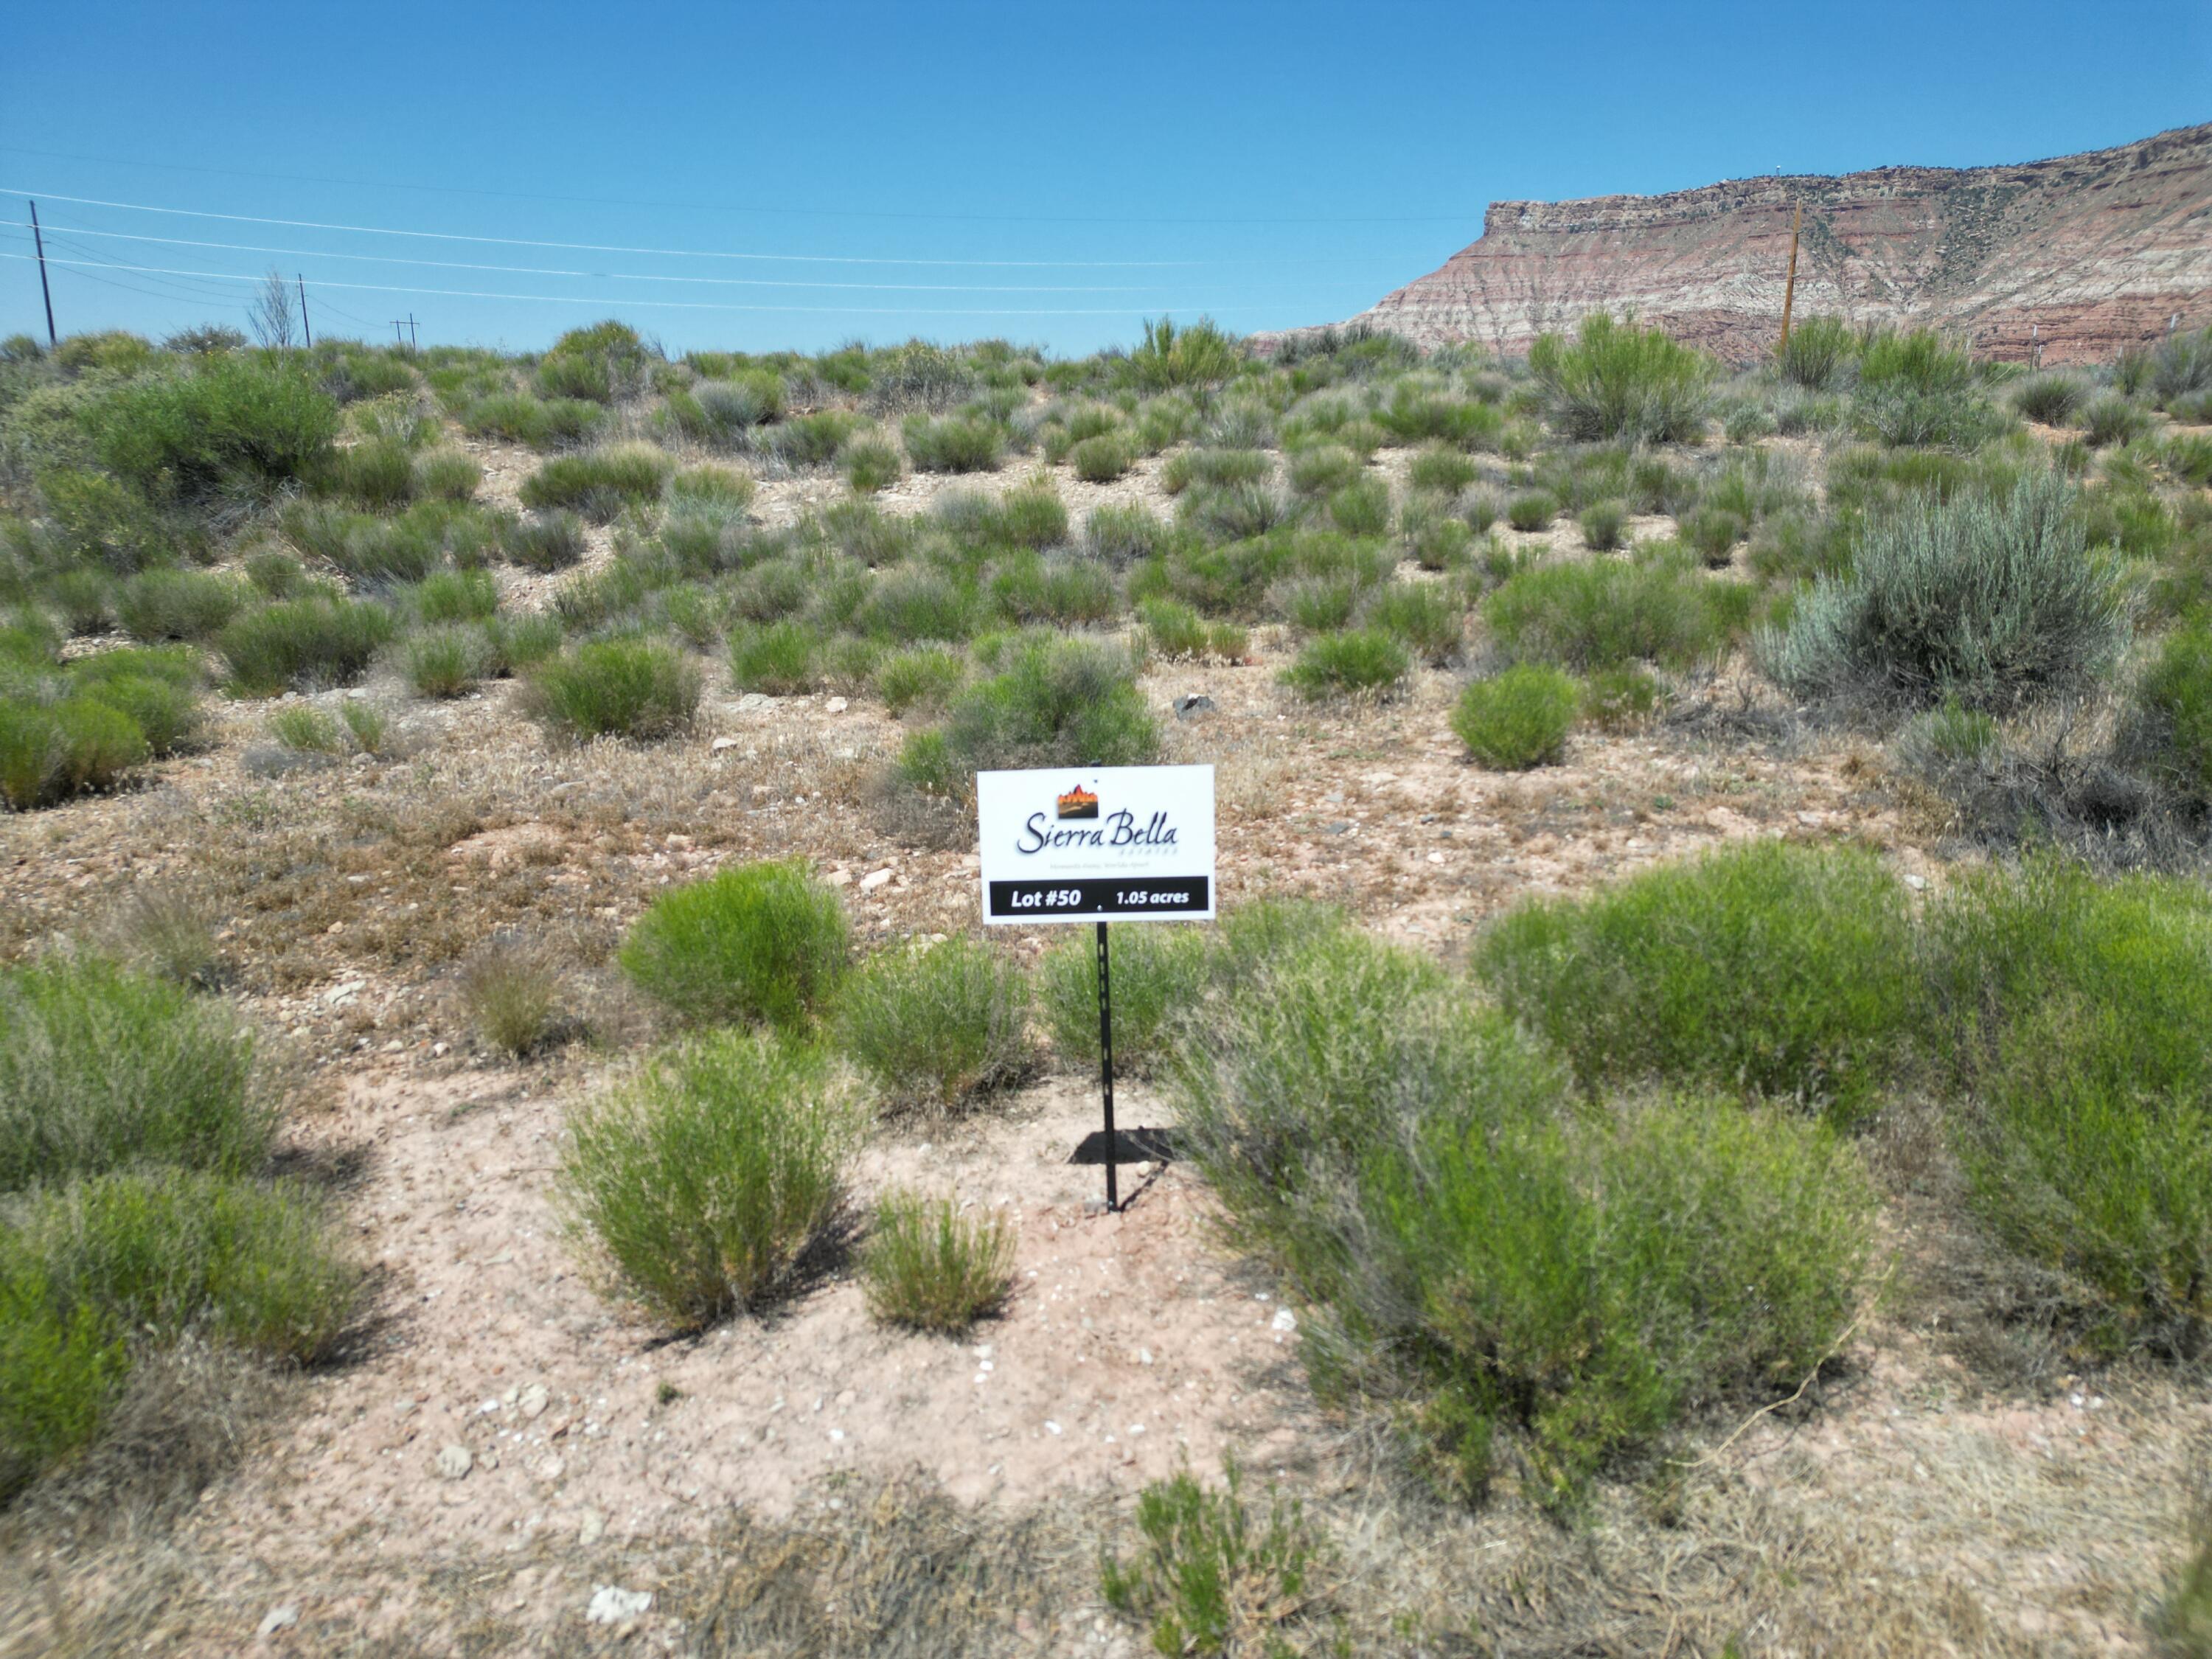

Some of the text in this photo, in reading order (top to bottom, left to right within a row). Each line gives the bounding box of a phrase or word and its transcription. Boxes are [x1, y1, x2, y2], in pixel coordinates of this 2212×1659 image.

[1017, 808, 1178, 854] Sierra Bella
[1011, 889, 1082, 907] Lot #50
[1116, 891, 1189, 904] 1.05 acres
